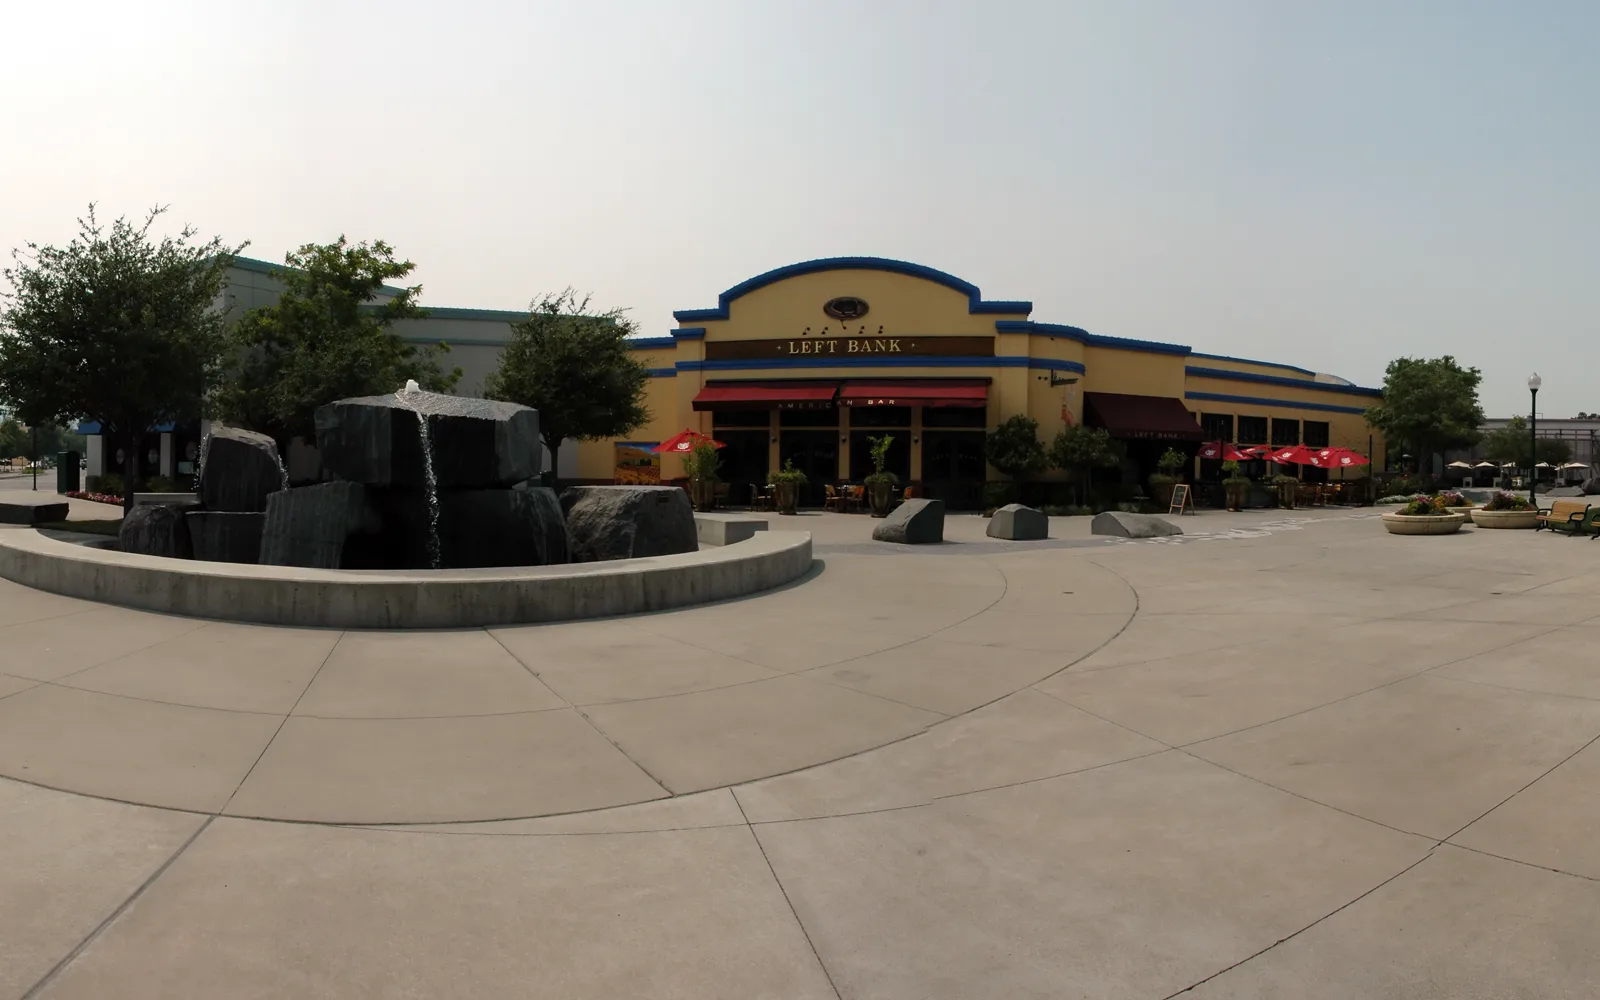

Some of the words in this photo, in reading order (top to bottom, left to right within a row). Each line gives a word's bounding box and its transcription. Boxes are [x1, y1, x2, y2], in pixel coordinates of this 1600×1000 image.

[788, 341, 838, 354] LEFT
[847, 339, 902, 353] BANK
[778, 400, 853, 409] AMERICAN
[1134, 430, 1154, 438] LEFT
